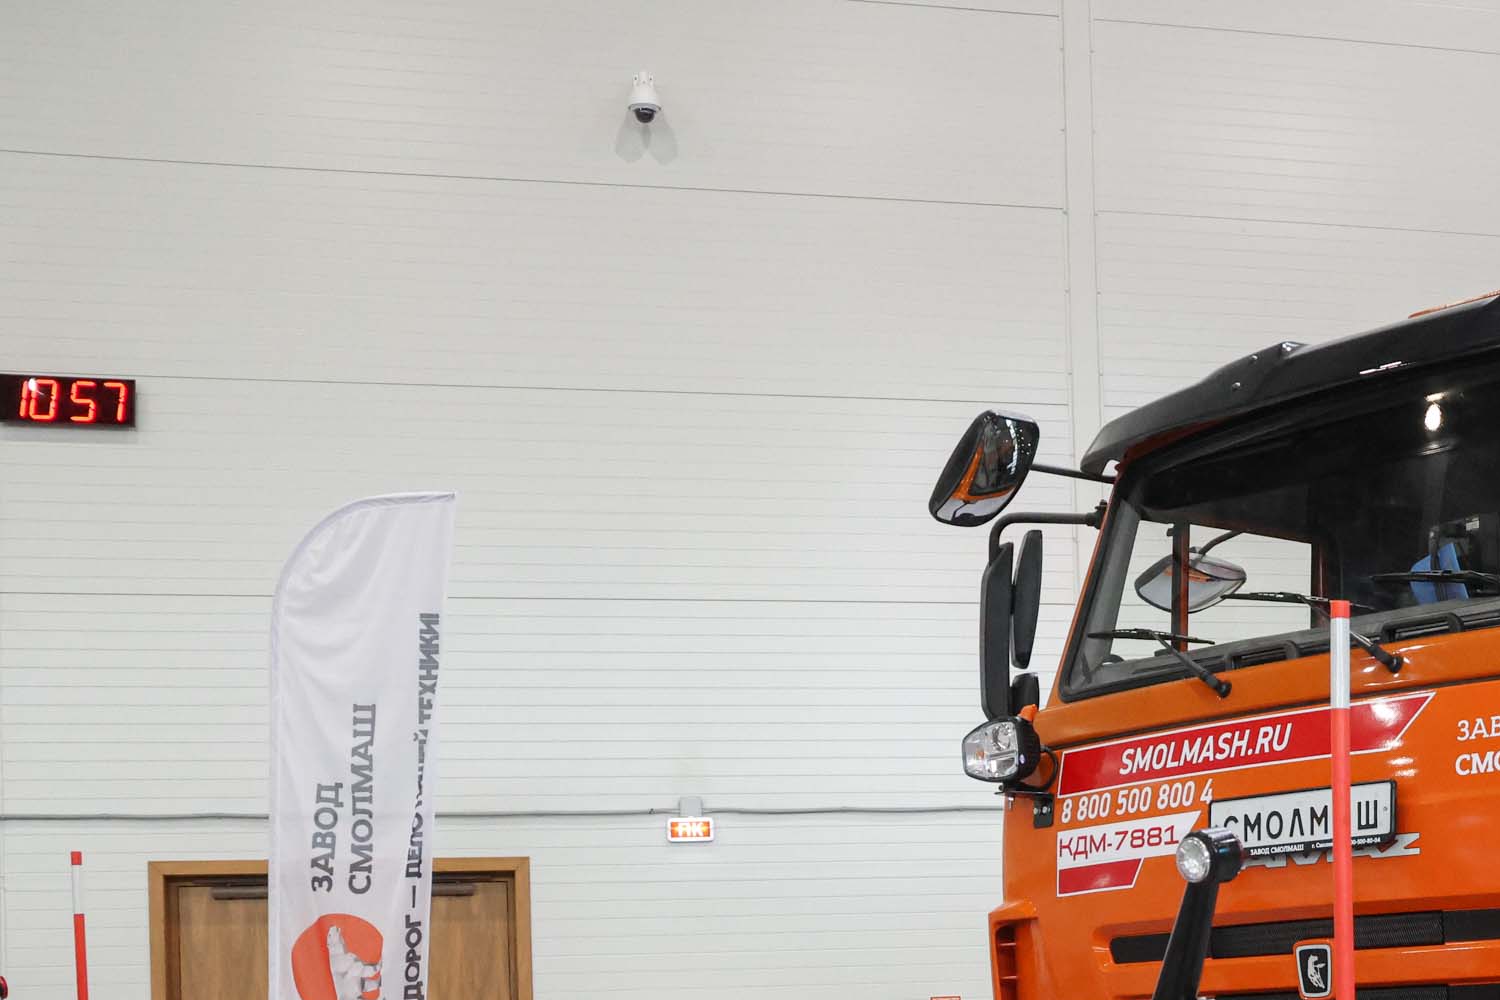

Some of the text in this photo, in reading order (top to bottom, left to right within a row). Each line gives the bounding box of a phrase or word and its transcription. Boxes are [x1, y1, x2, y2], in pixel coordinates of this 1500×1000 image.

[1118, 723, 1293, 776] SMOLMASH.RU
[348, 703, 376, 895] СМОЛМАШ
[1061, 778, 1214, 824] 8 800 500 800 4
[1223, 799, 1378, 842] МОЛМШ
[311, 782, 343, 893] ЗАВОД
[1059, 825, 1180, 861] КДМ-7881
[403, 915, 425, 1000] ДОРОГ
